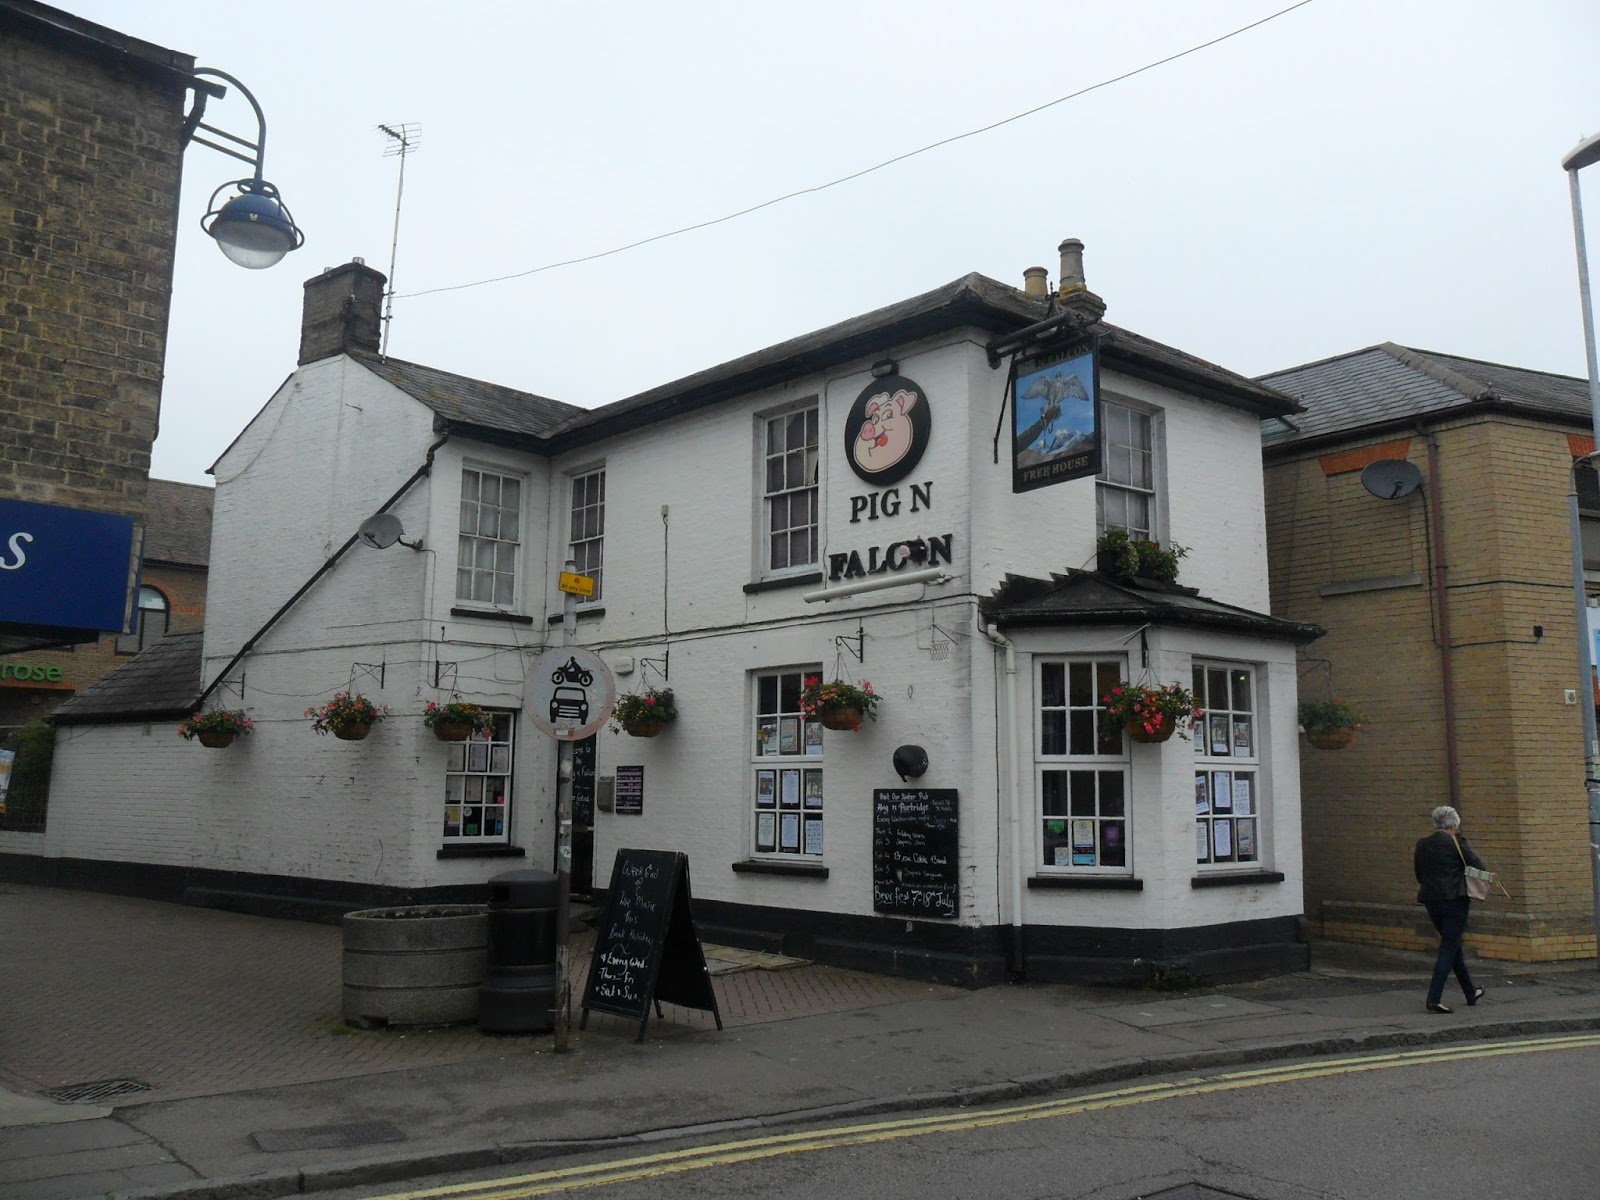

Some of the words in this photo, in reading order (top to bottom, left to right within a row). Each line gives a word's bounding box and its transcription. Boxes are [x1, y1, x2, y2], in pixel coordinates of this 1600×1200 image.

[1023, 466, 1050, 481] FREE
[1052, 455, 1088, 473] HOUSE
[849, 488, 901, 523] PIG
[909, 481, 933, 512] N
[828, 533, 953, 580] FALCN
[898, 802, 929, 815] Partridge
[874, 885, 894, 901] Beer
[935, 892, 956, 913] July
[606, 952, 629, 977] Every
